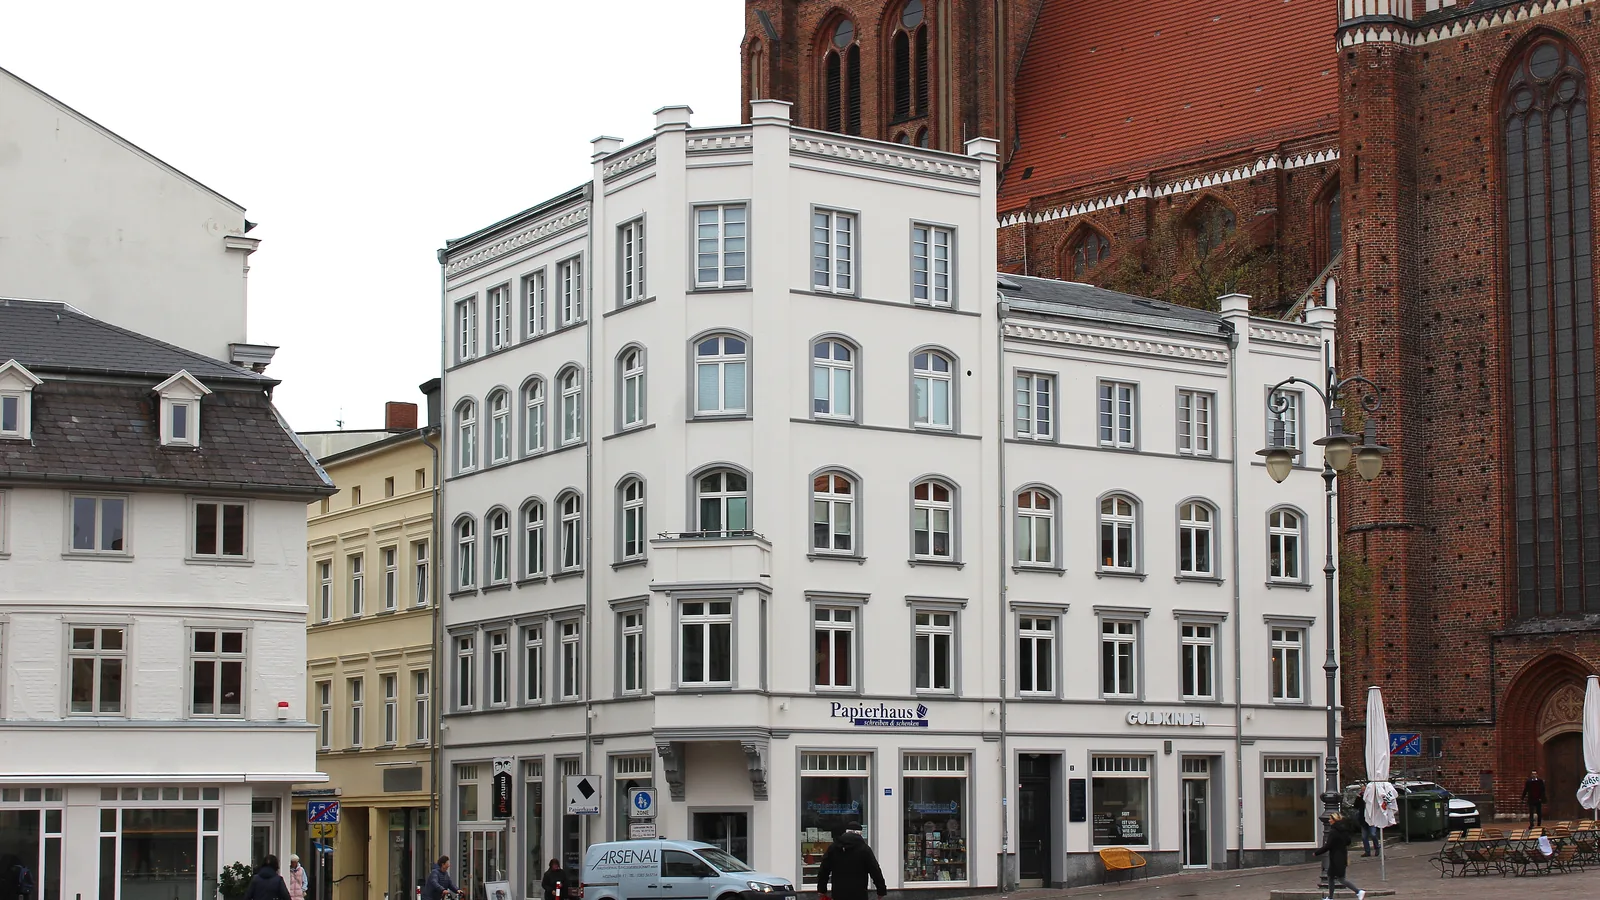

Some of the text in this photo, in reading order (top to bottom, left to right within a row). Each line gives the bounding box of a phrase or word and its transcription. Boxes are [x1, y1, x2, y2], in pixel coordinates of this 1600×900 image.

[830, 702, 913, 723] Papierhaus
[568, 806, 594, 814] Papierhaus
[592, 849, 658, 870] ARSENAL
